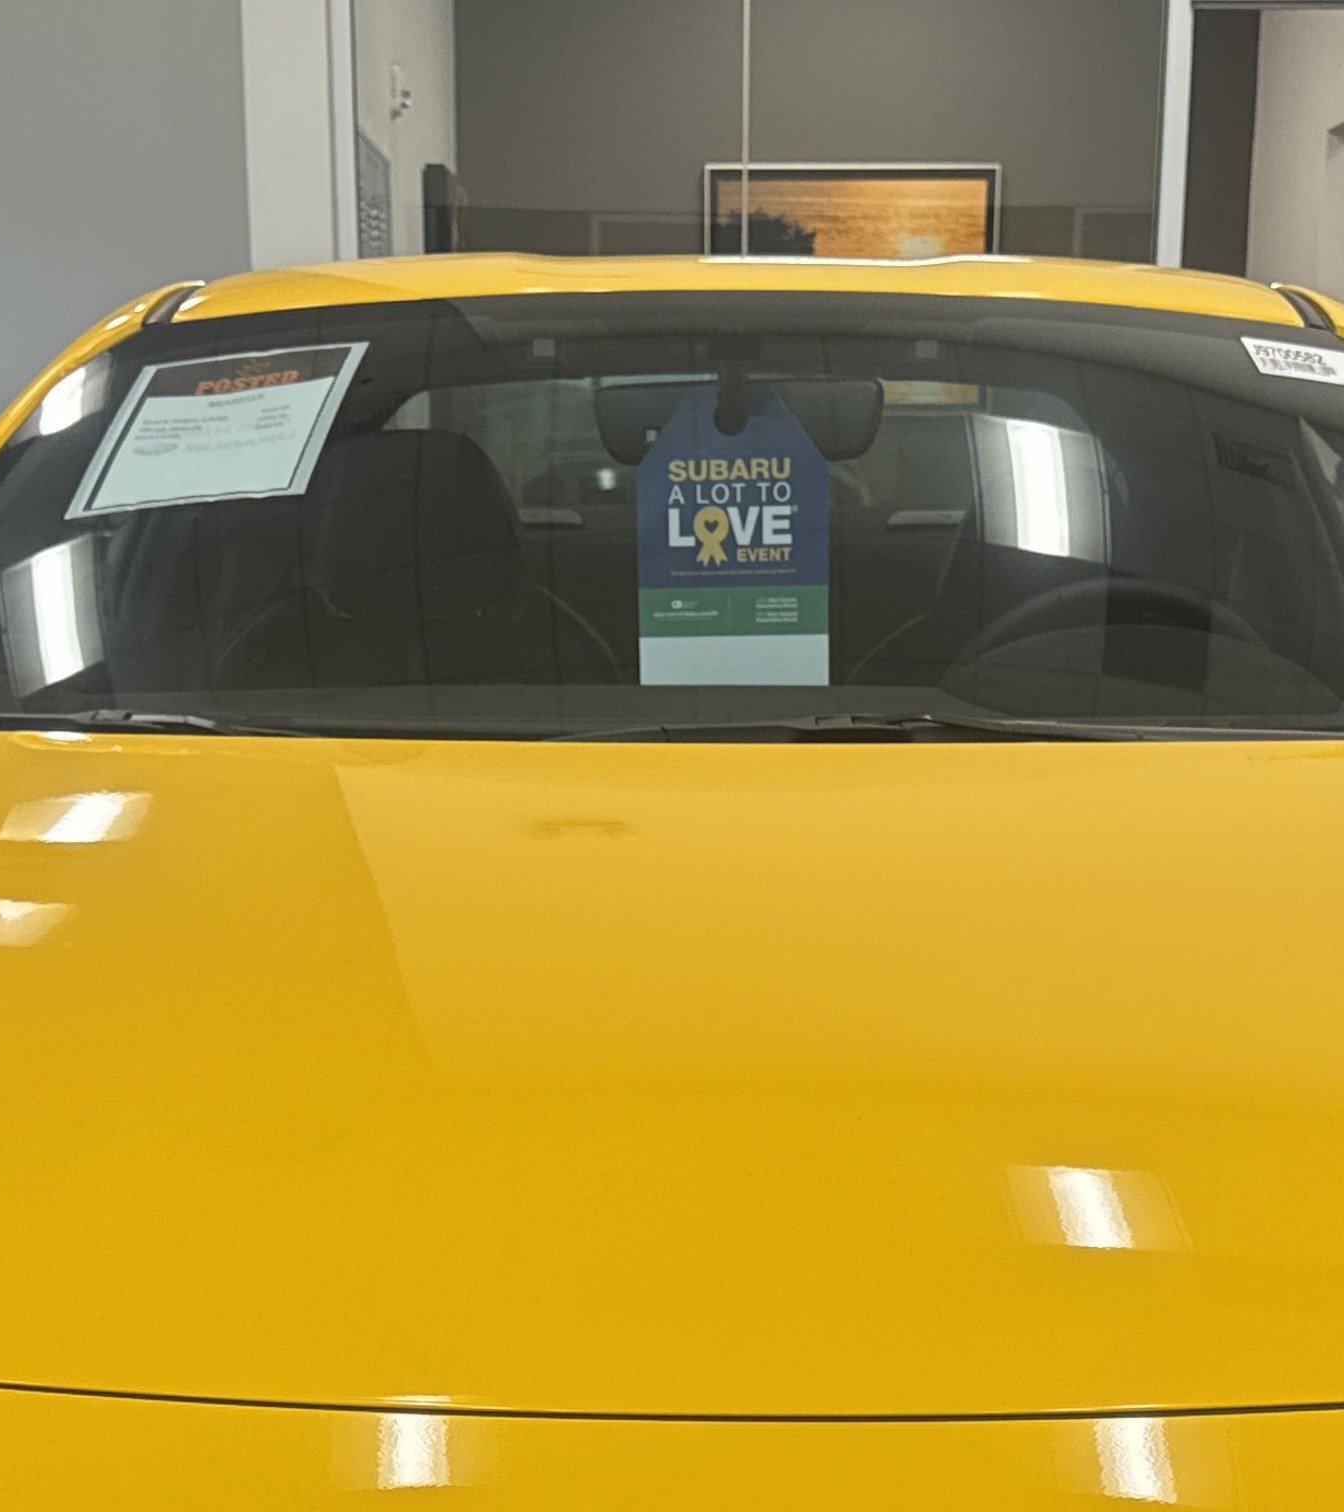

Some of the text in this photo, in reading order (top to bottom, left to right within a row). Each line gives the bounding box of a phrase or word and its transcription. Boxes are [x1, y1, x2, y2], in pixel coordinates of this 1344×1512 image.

[668, 457, 792, 482] SUBARU
[668, 481, 792, 505] A LOT TO
[668, 505, 793, 548] LOVE
[736, 547, 793, 563] EVENT
